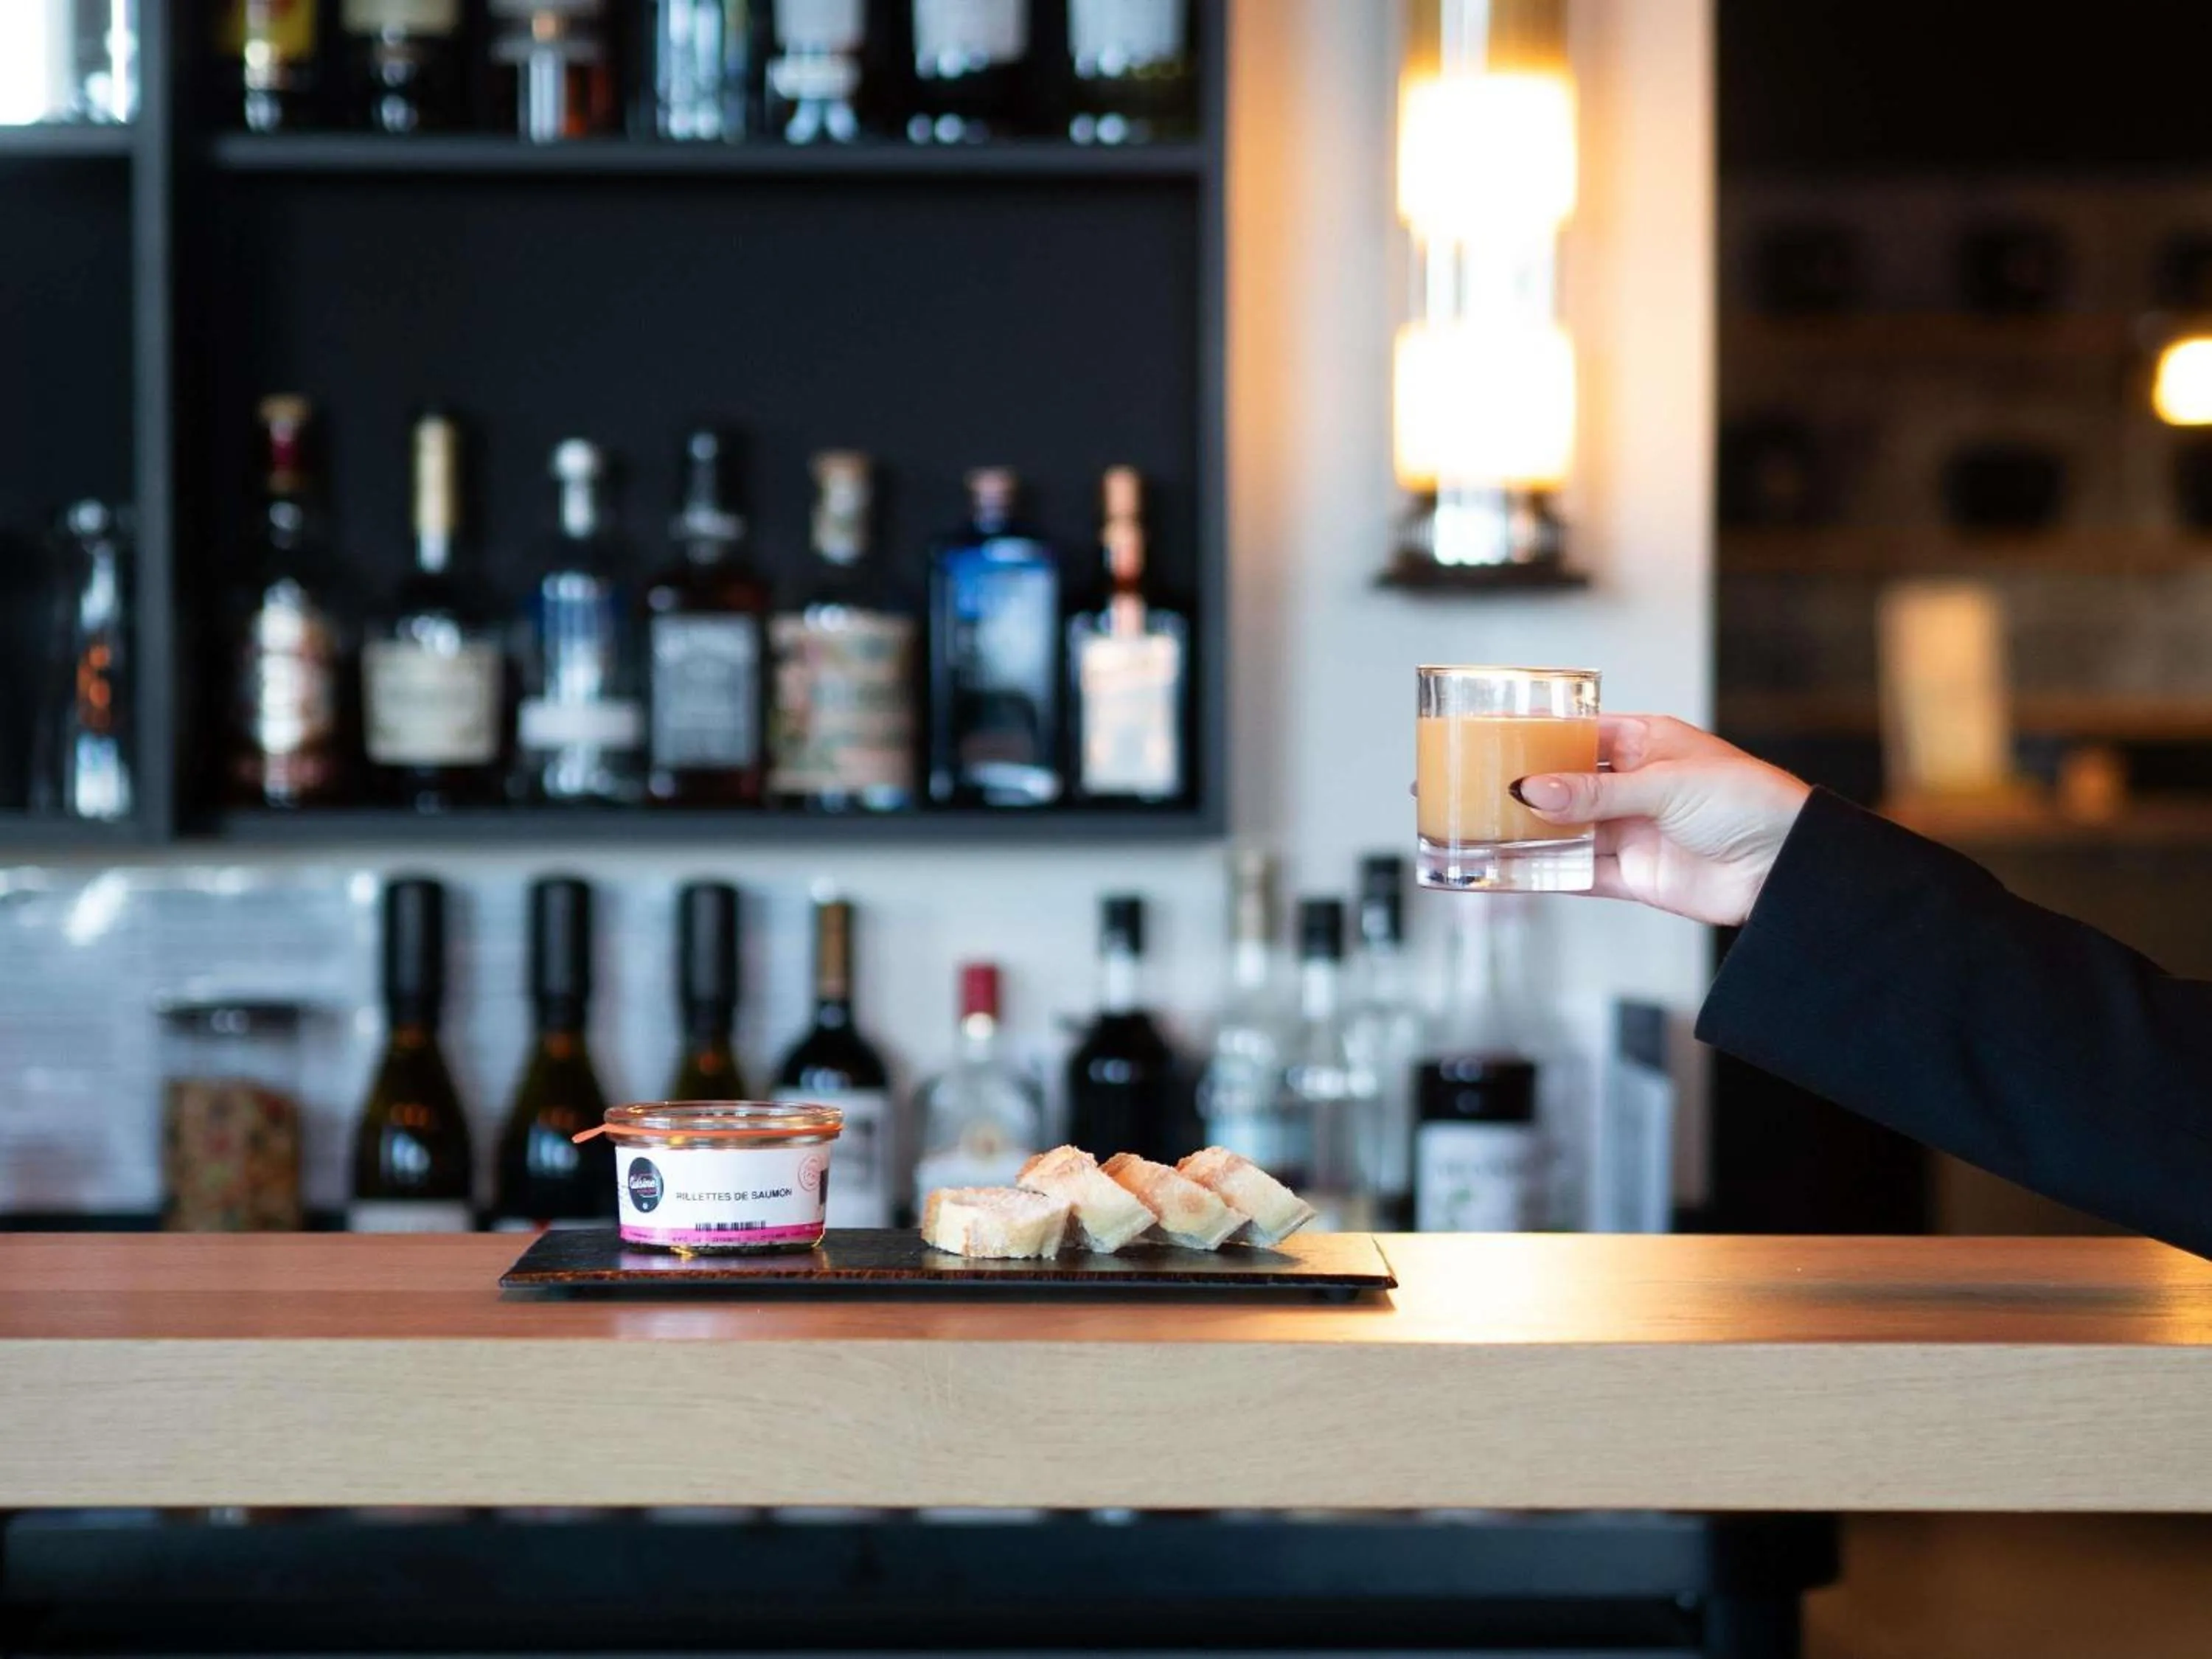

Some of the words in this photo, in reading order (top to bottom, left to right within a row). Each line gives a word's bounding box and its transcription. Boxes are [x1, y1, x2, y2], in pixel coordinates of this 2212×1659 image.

[676, 1192, 731, 1201] RILLETTES
[735, 1192, 748, 1201] DE
[752, 1188, 792, 1200] SAUMON
